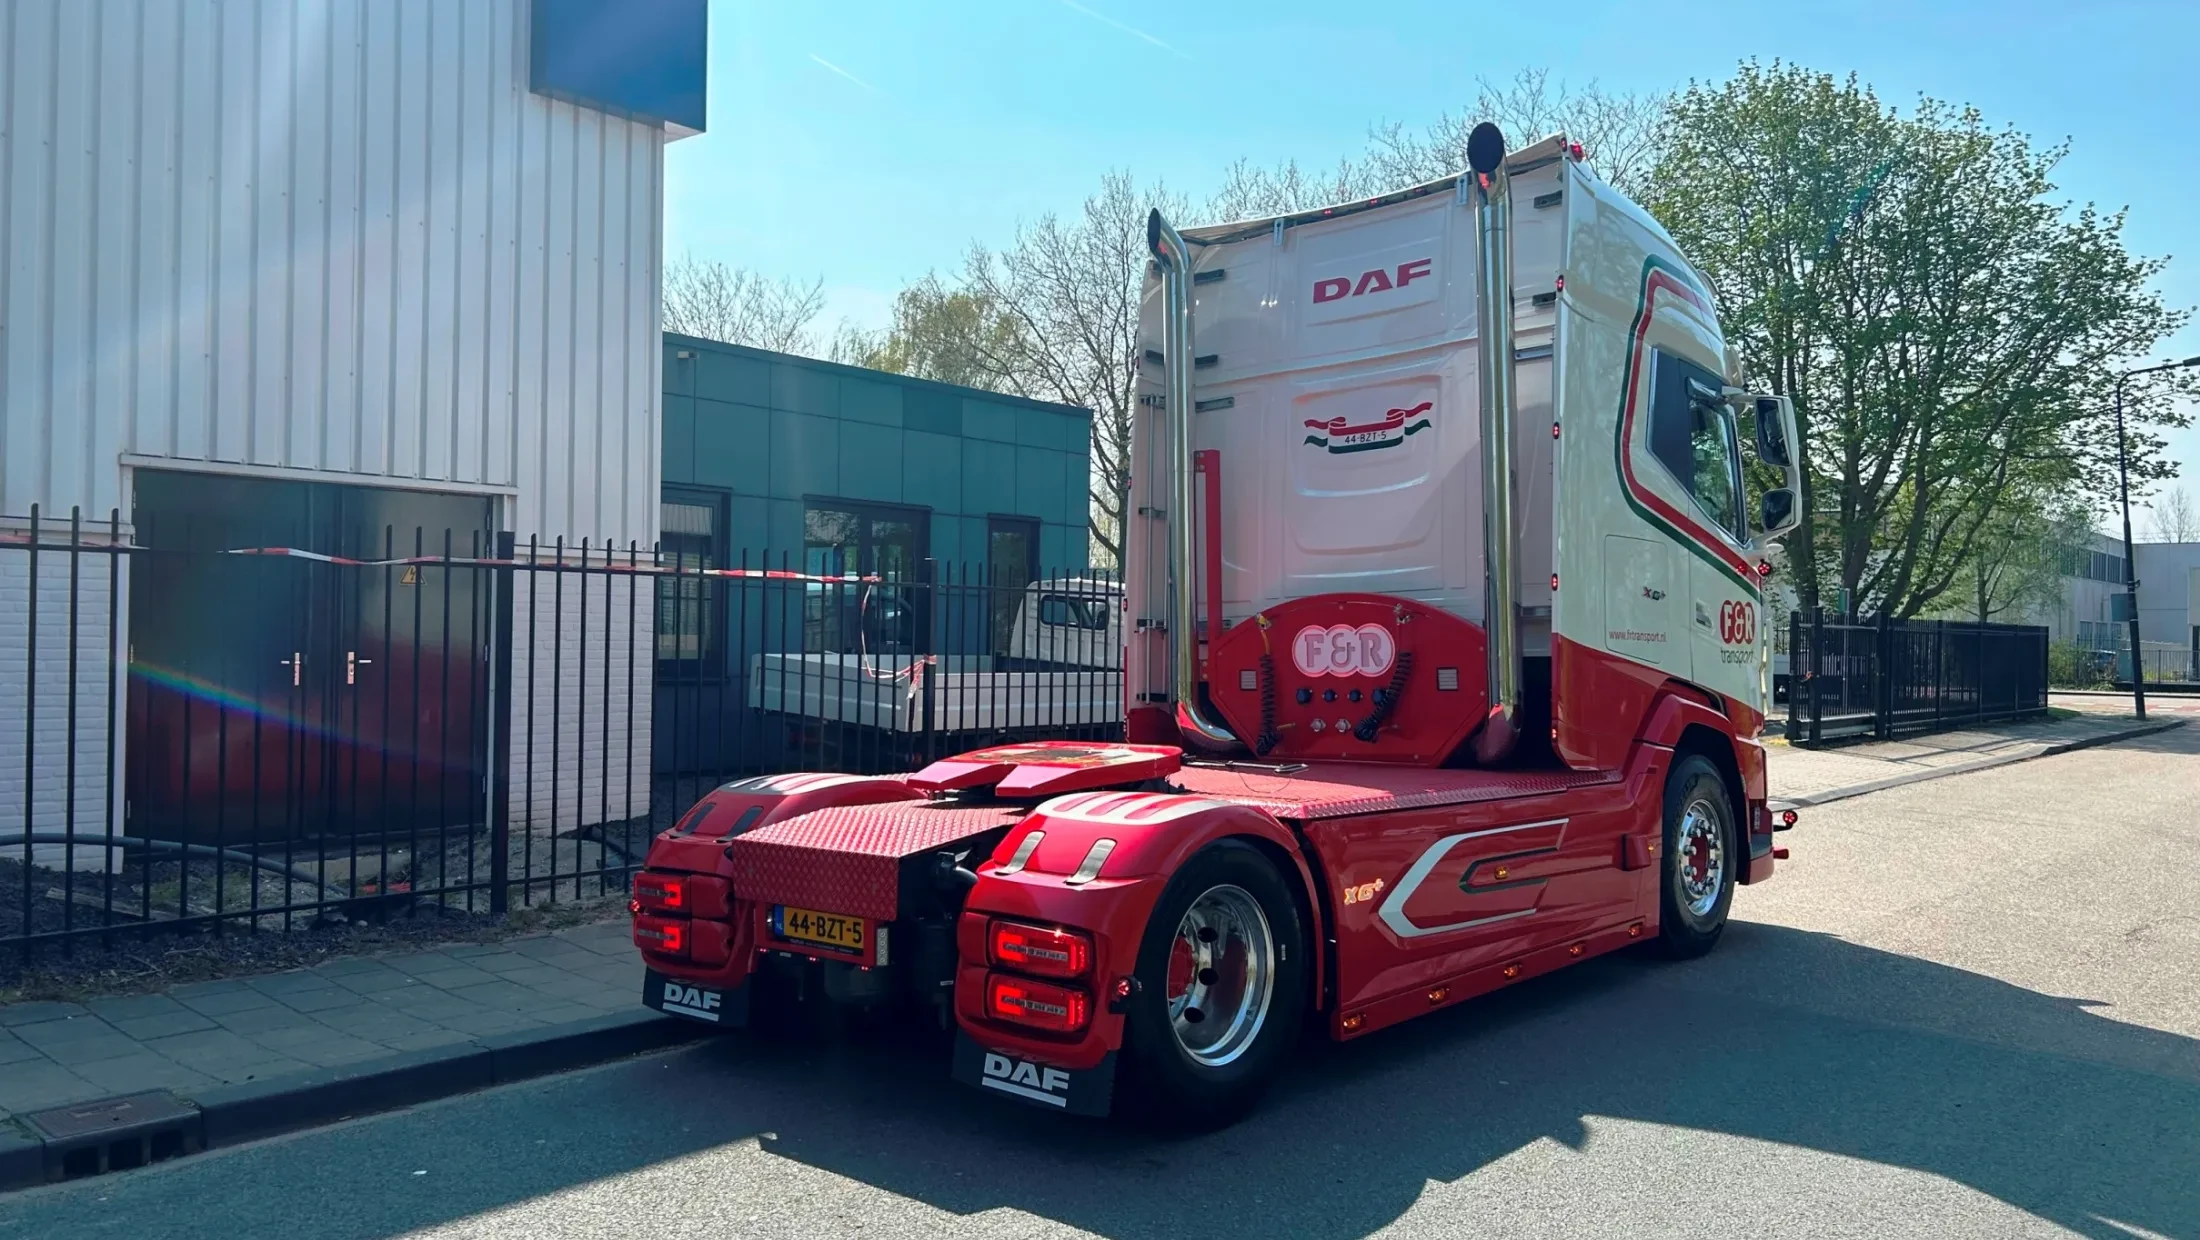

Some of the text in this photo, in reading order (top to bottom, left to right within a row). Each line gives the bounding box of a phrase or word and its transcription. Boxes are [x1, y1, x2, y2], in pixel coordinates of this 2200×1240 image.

[1313, 258, 1432, 304] DAF
[1344, 431, 1387, 444] 44-BZT-5
[1723, 604, 1753, 640] F&R
[1304, 632, 1383, 668] F&R
[1720, 647, 1754, 668] transport
[789, 912, 862, 944] 44-BZT-5
[664, 982, 721, 1009] DAF
[983, 1052, 1070, 1091] DAF
